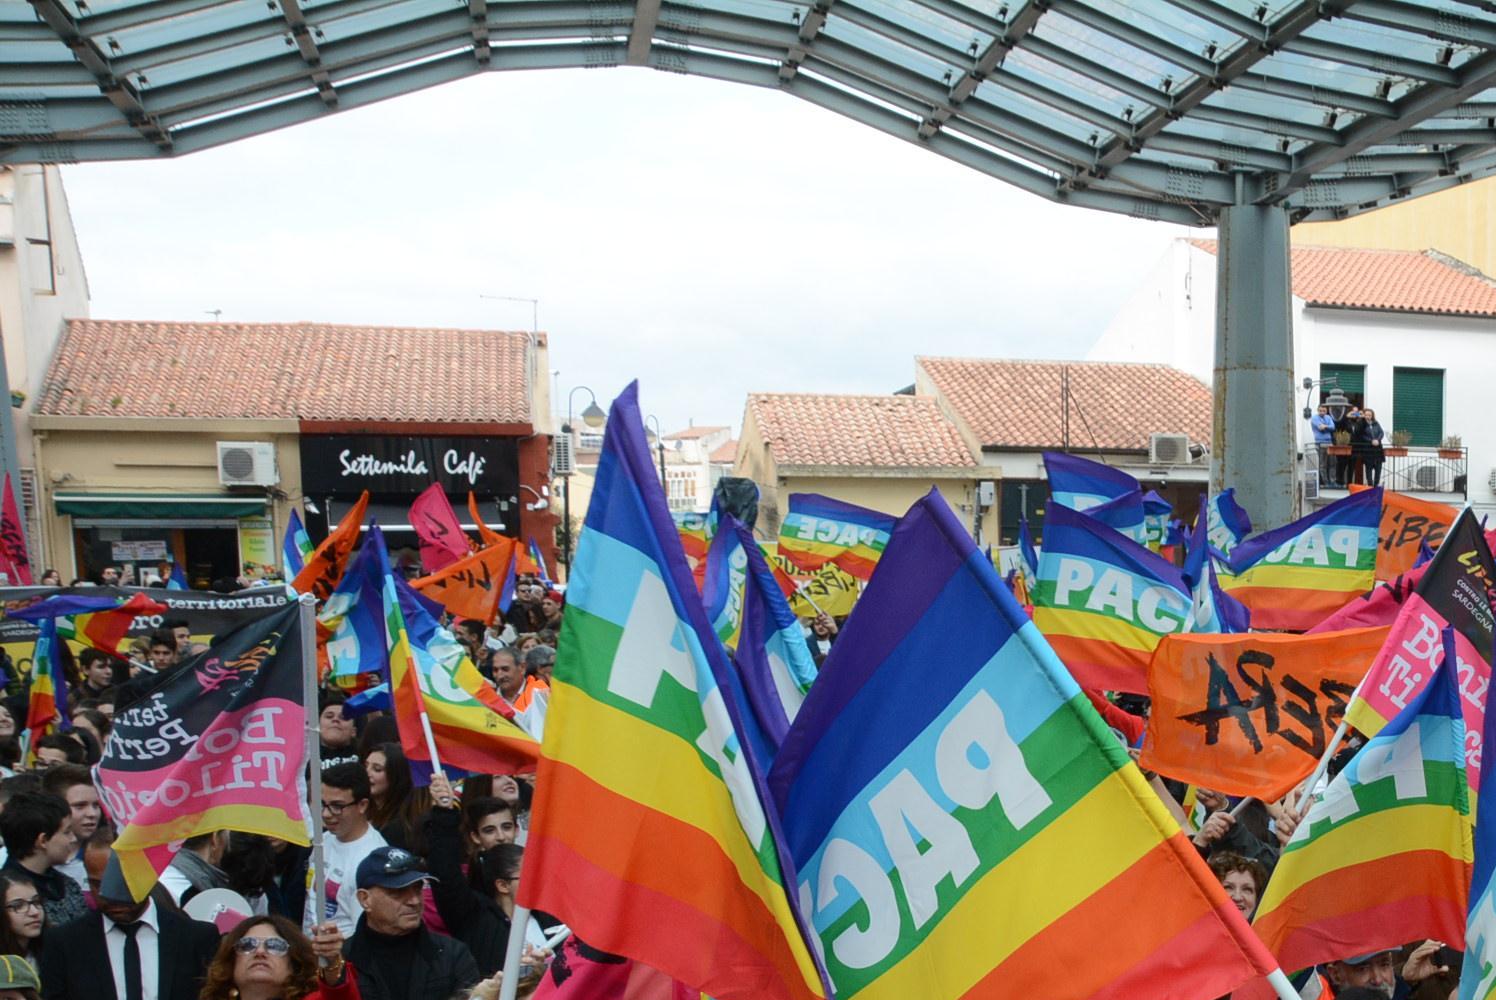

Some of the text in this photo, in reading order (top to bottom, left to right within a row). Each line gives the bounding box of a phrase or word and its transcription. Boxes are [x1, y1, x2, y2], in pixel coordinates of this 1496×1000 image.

[339, 449, 487, 485] Settemila Cafè
[167, 595, 287, 611] territoriale
[1054, 558, 1195, 634] PAC
[1452, 588, 1494, 633] SARDEGNA
